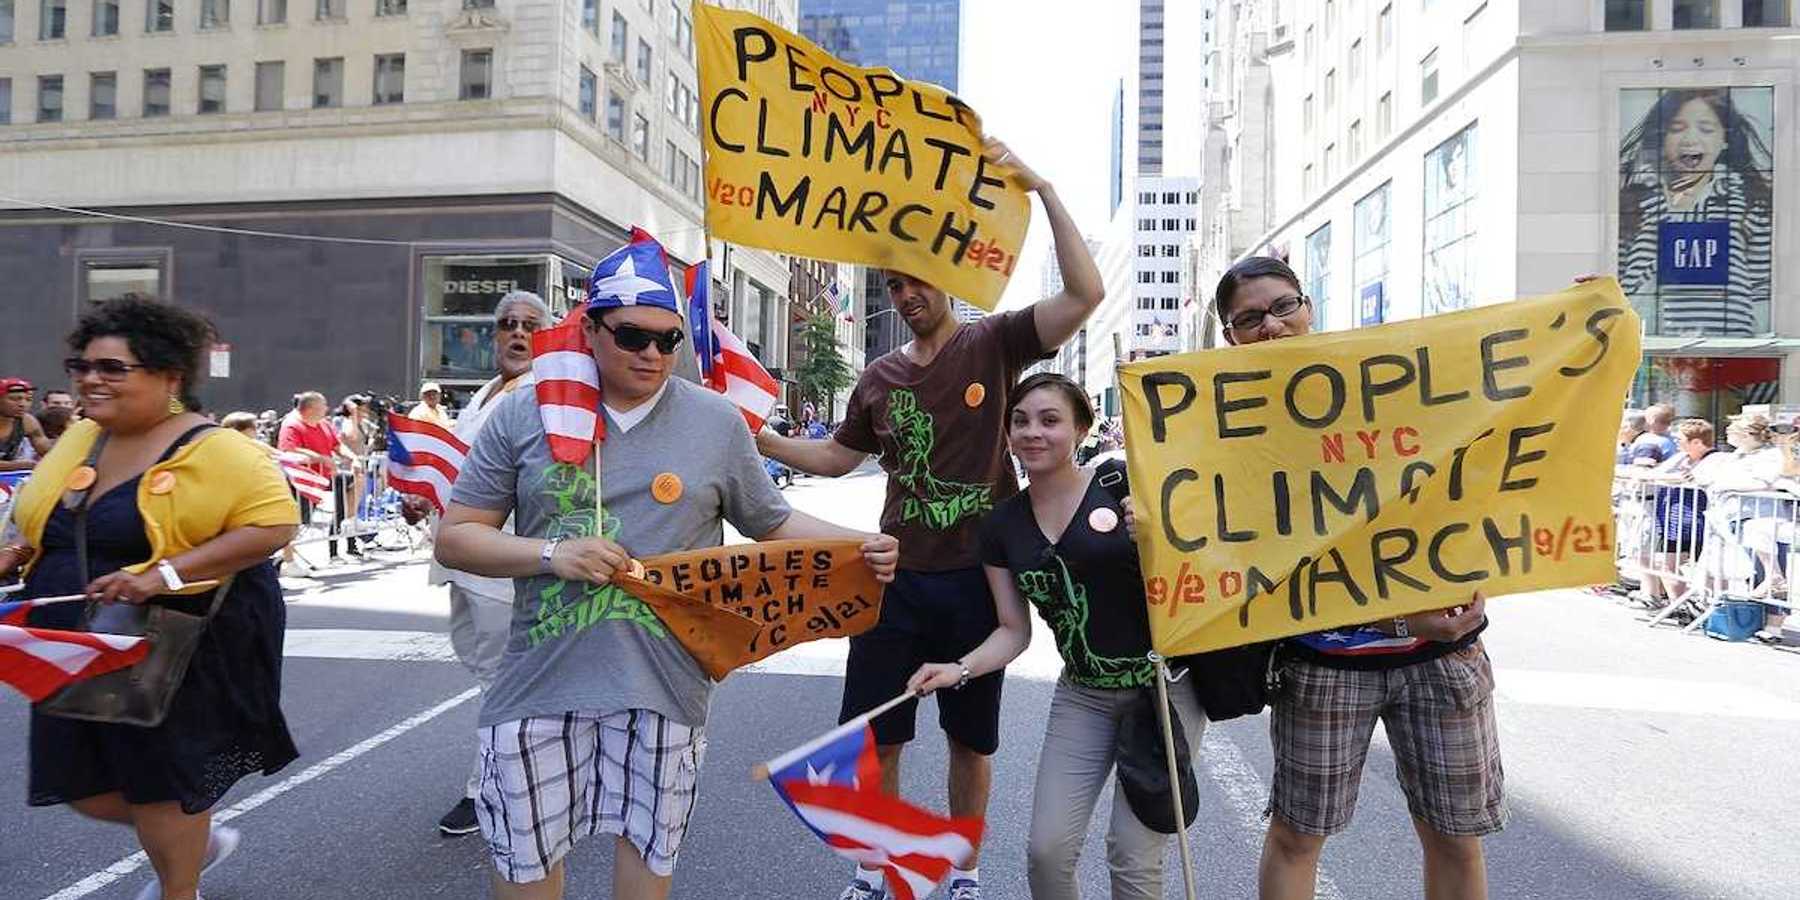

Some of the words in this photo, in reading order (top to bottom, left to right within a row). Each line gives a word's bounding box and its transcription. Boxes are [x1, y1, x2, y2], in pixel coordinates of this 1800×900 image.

[813, 90, 892, 129] NYC
[711, 88, 1006, 211] CLIMATE
[756, 171, 977, 265] MARCH
[1674, 239, 1717, 268] GAP
[1142, 308, 1623, 443] PEOPLE'S
[1321, 427, 1421, 464] NYC
[1239, 513, 1532, 628] MARCH
[1533, 516, 1613, 562] 9/21
[806, 593, 873, 633] 9/21
